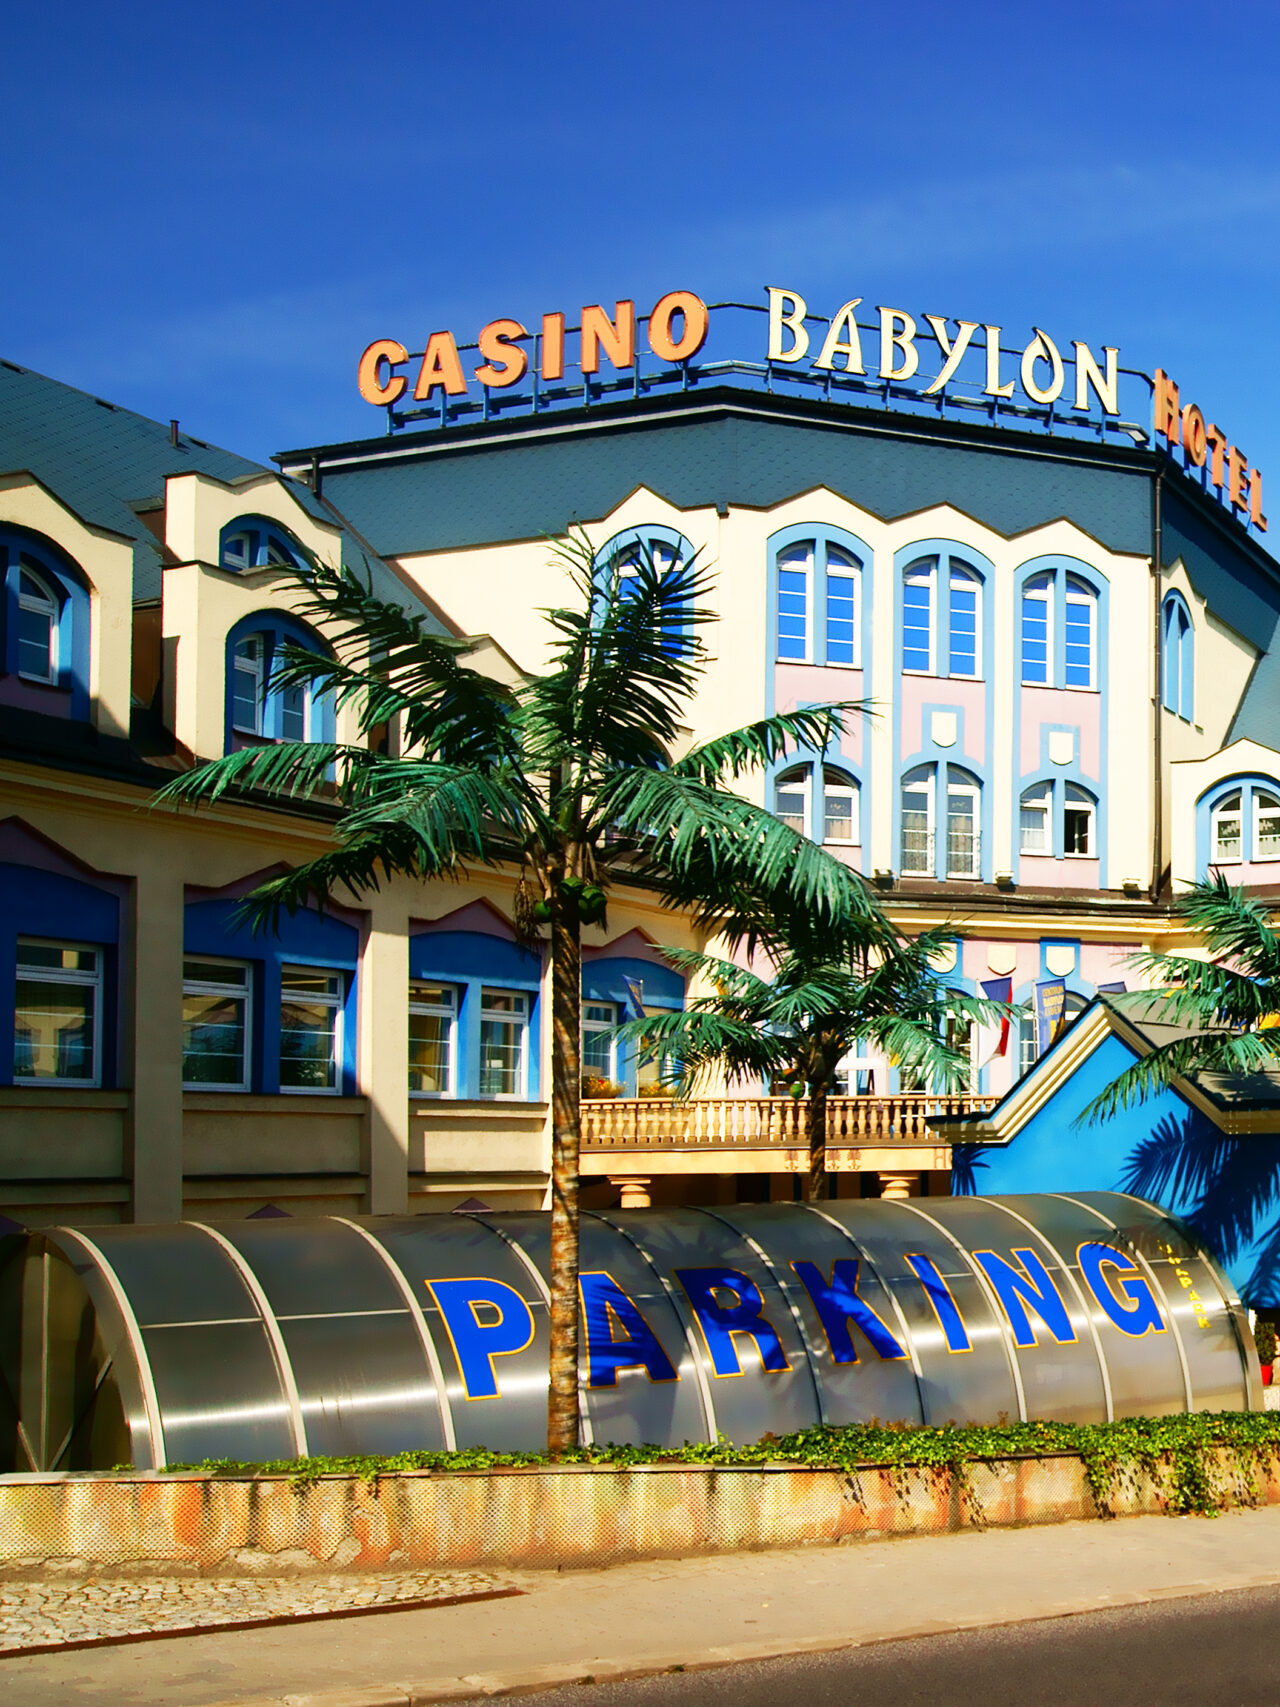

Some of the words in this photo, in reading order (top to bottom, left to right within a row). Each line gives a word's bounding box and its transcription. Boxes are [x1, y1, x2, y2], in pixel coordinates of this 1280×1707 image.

[358, 290, 709, 406] CASINO
[1154, 367, 1269, 533] HOTEL
[425, 1240, 1167, 1403] PARKING
